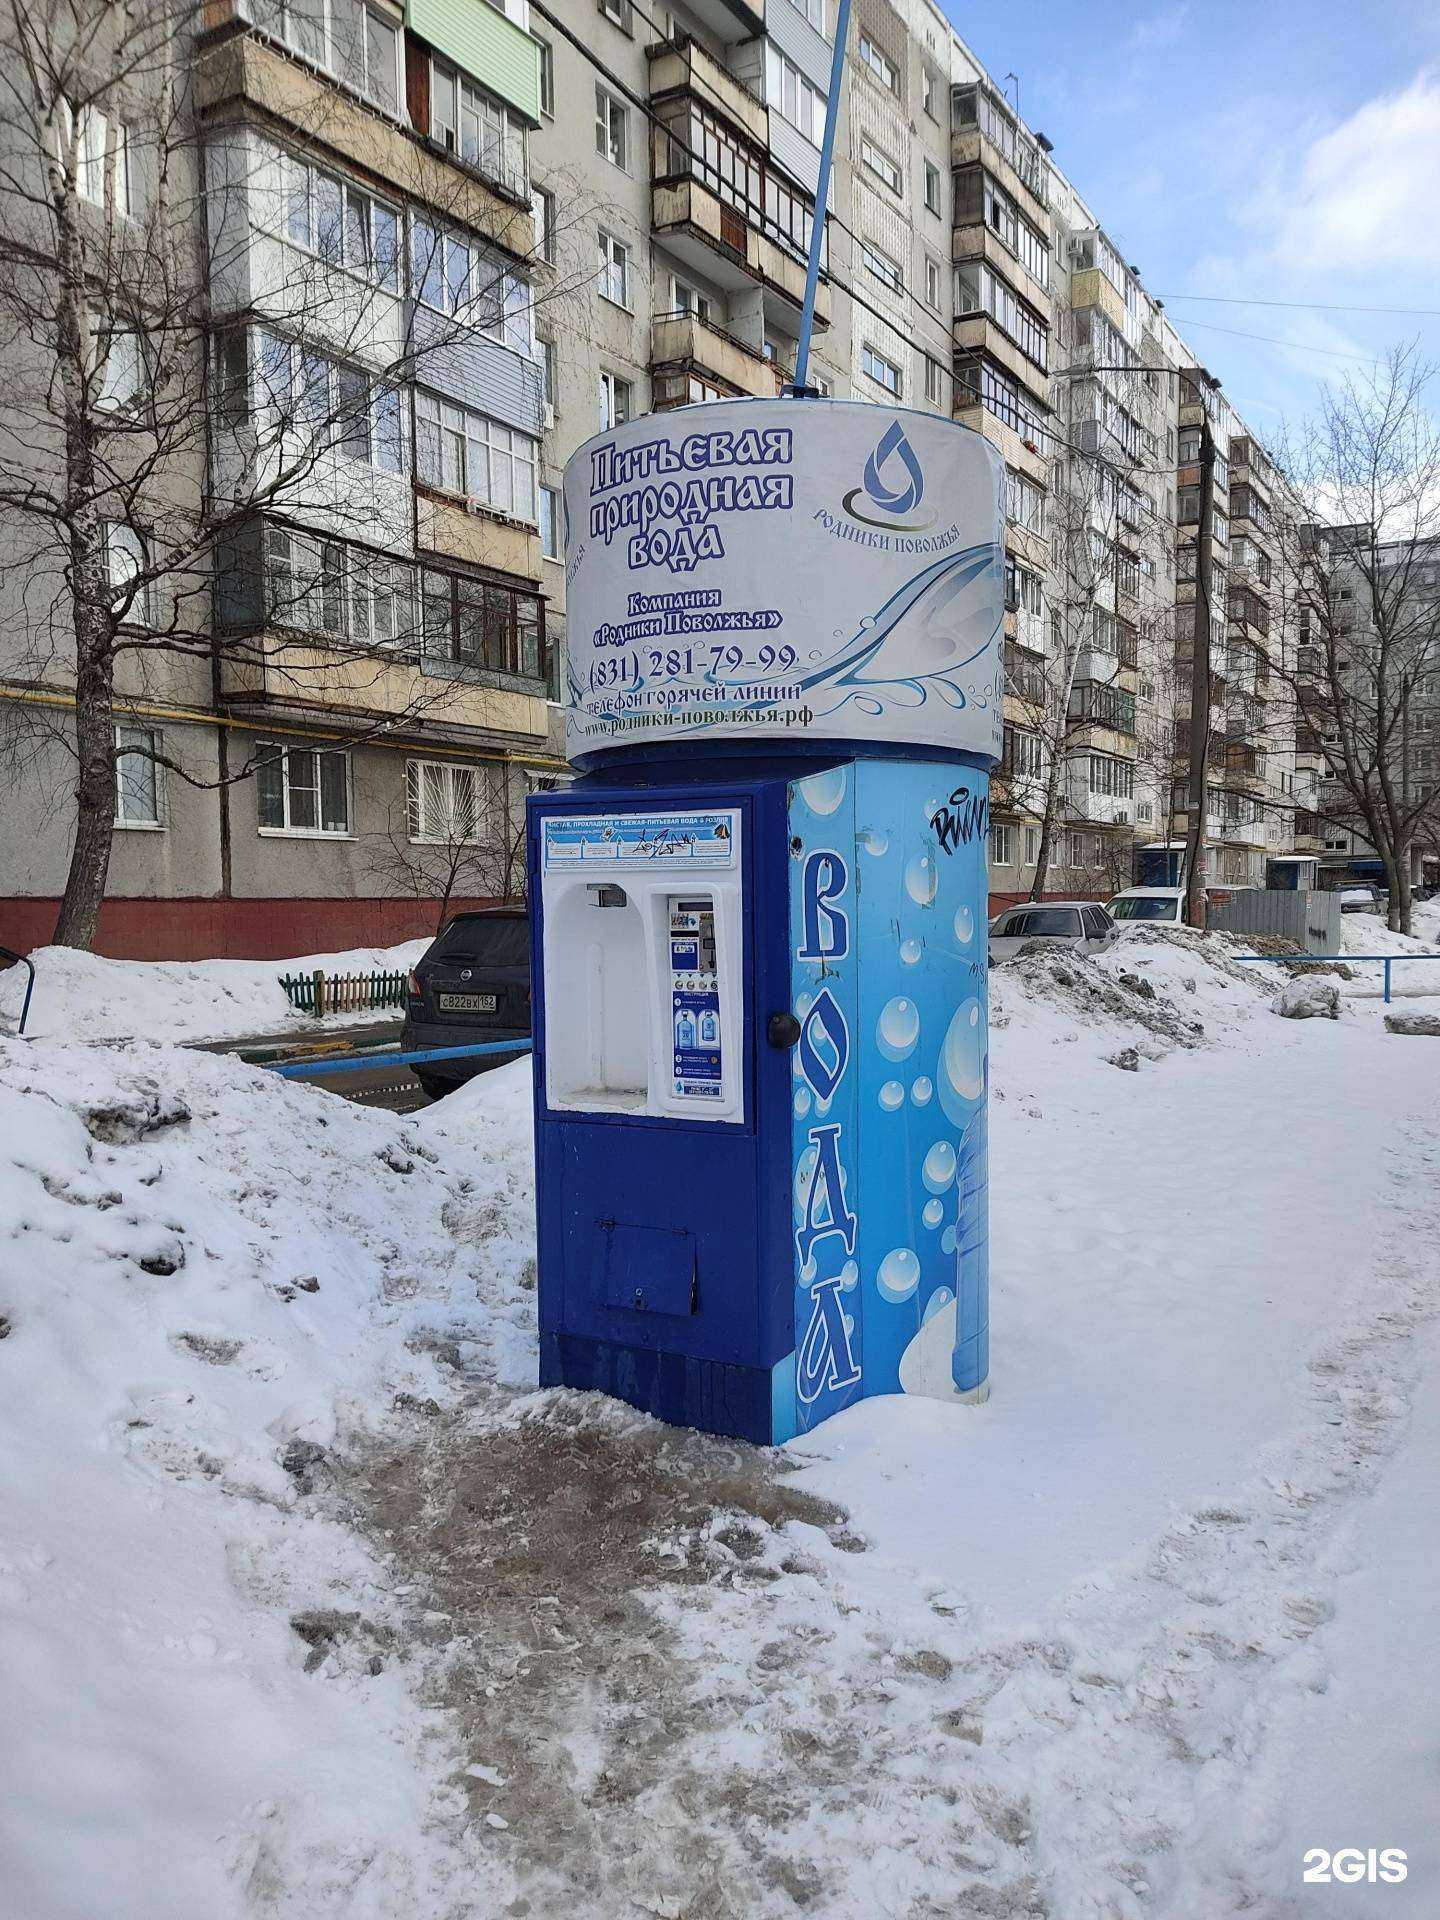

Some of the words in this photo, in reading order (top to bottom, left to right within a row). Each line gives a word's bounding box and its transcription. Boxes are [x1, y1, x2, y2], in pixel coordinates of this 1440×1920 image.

[628, 589, 722, 617] Компания
[590, 651, 640, 695] (831)
[649, 644, 797, 677] 281-79-99
[480, 996, 494, 1007] 152
